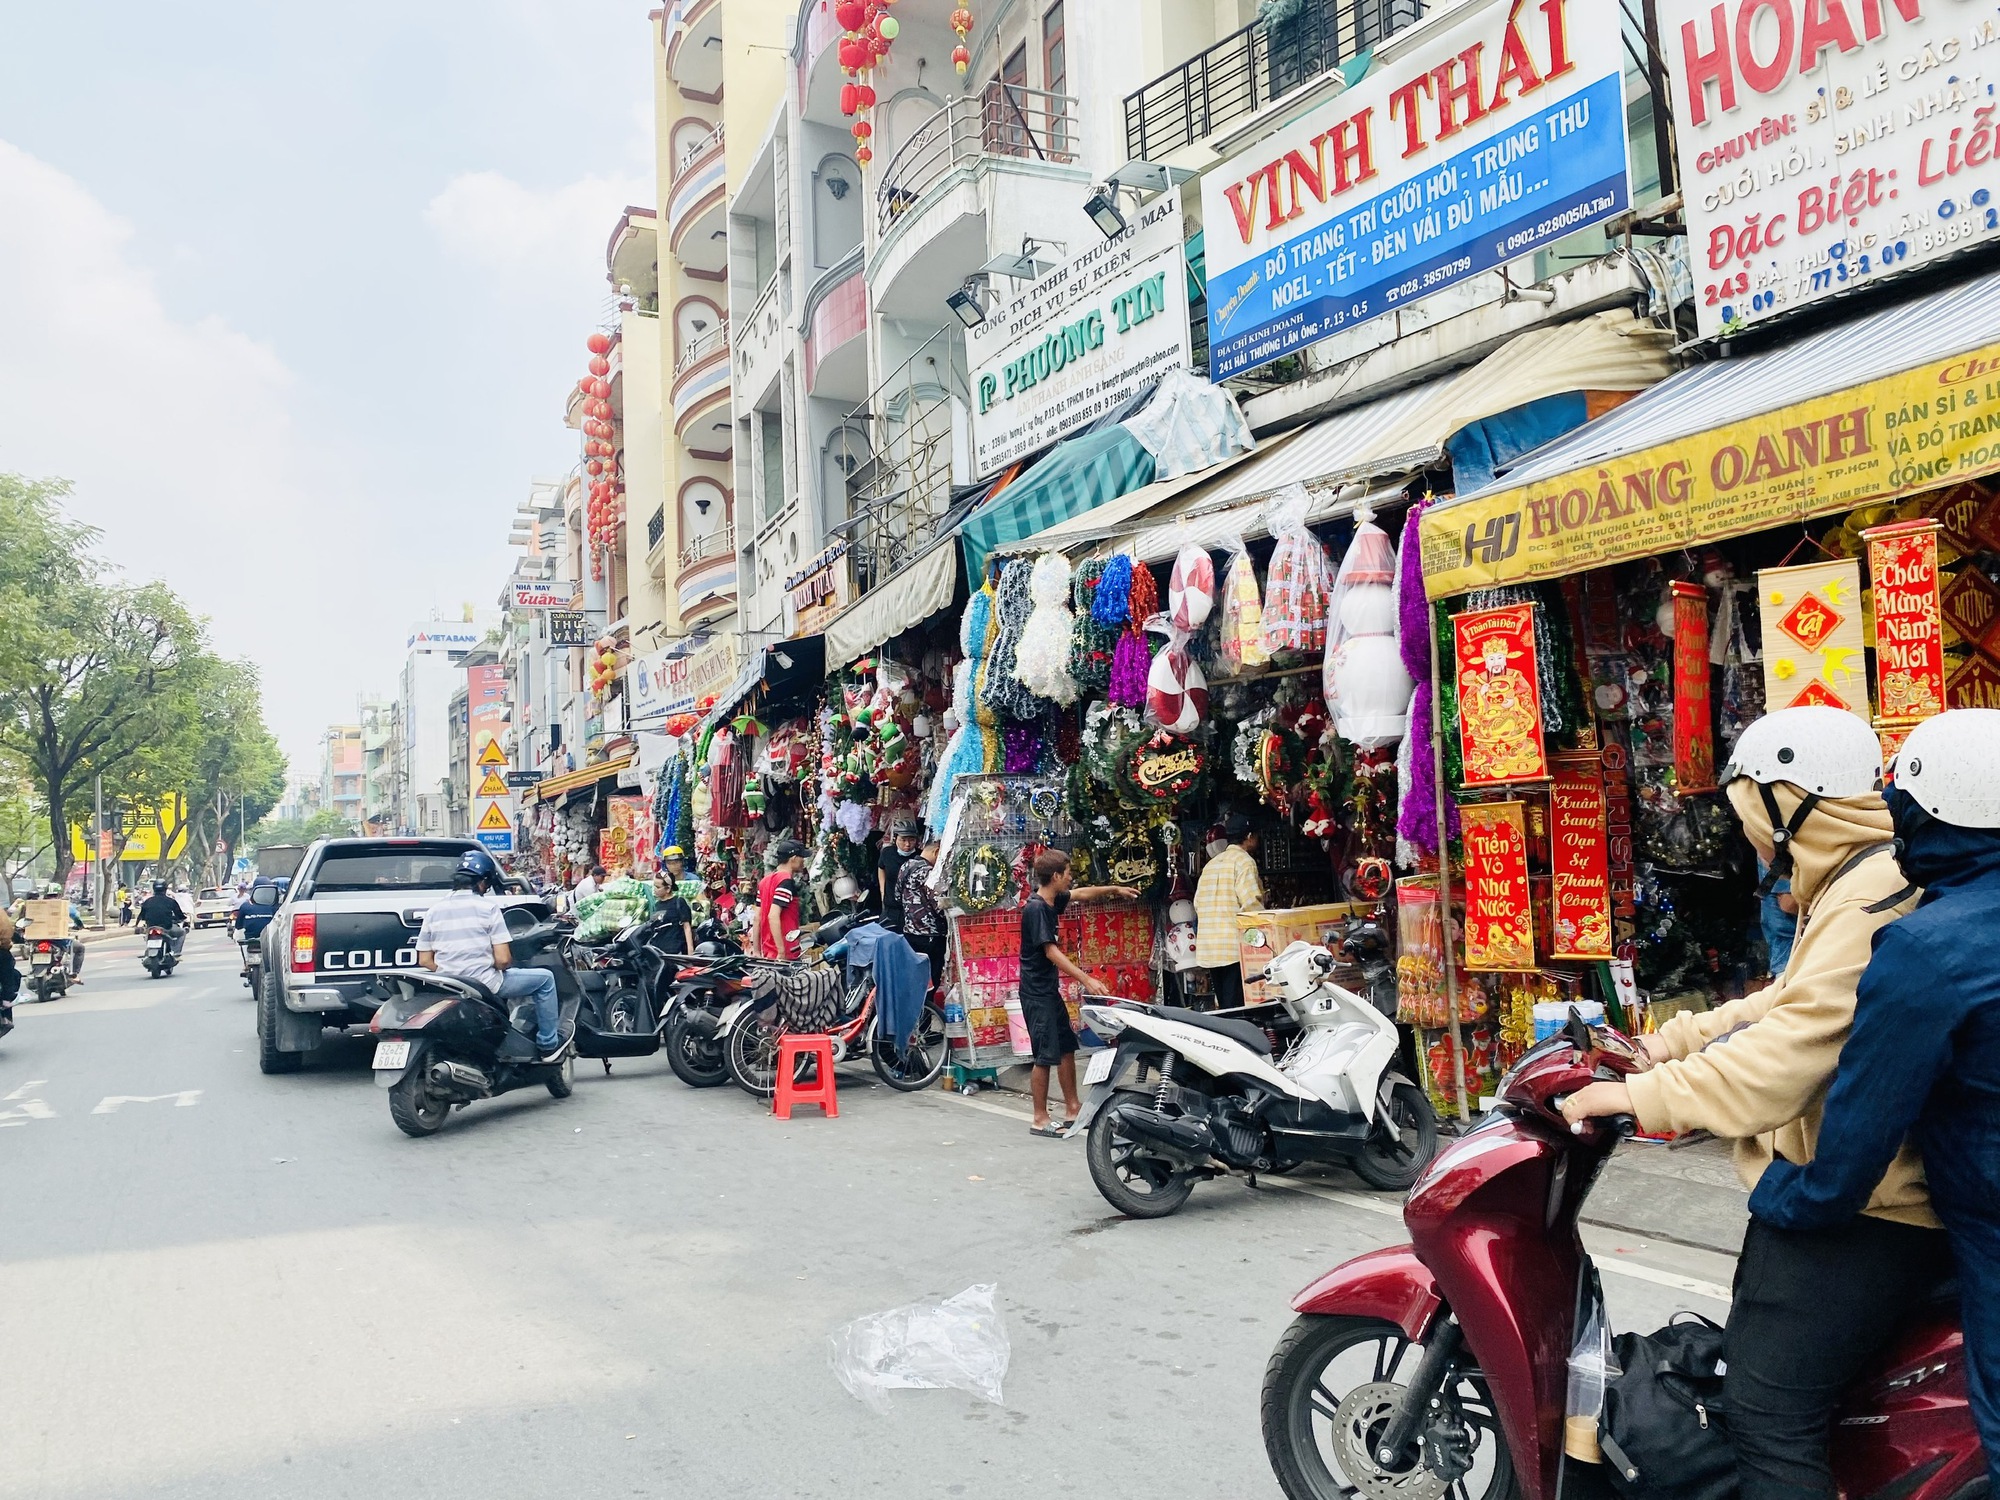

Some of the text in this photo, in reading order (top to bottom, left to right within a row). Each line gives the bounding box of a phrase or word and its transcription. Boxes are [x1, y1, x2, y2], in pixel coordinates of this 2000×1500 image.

[1223, 0, 1576, 244] VINH THÁI
[1696, 113, 1797, 174] CHUYÊN:
[1835, 86, 1854, 111] &
[1834, 109, 1896, 156] SINH
[1265, 97, 1590, 281] ĐỒ TRANG TRÍ CƯỚI HỎI TRUNG THU
[1707, 102, 2000, 271] Đặc Biệt: Liễ
[1010, 293, 1027, 315] TY
[1030, 270, 1069, 301] TNHH
[1141, 198, 1174, 231] MẠI
[1271, 275, 1312, 311] NOEL
[1326, 247, 1358, 285] TẾT
[1371, 229, 1406, 266] ĐÈN
[1412, 207, 1441, 245] VẢI
[1447, 190, 1474, 231] ĐỦ
[1836, 254, 1872, 283] 352
[1009, 307, 1043, 337] DỊCH
[1092, 248, 1132, 283] KIỆN
[1704, 271, 1750, 307] 243
[1002, 271, 1166, 401] PHƯƠNG TIN
[1248, 327, 1270, 344] KINH
[1272, 312, 1304, 334] DOANH
[1218, 358, 1233, 375] 241
[1885, 402, 1929, 430] BÁN
[1936, 389, 1956, 415] SỈ
[1964, 389, 1979, 407] &
[1887, 433, 1912, 458] VÀ
[1917, 420, 1944, 451] ĐỒ
[1528, 406, 1876, 539] HOÀNG OANH
[1743, 490, 1757, 500] 13
[1826, 458, 1880, 480] TP.HCM
[1889, 457, 1952, 488] CỔNG
[1636, 525, 1663, 537] 733
[1668, 517, 1694, 530] 515
[1707, 507, 1735, 521] 094
[1786, 487, 1816, 501] 352
[1881, 558, 1931, 588] Chúc
[1879, 590, 1934, 617] Mừng
[1885, 616, 1932, 642] Năm
[1891, 643, 1929, 670] Mới
[1557, 795, 1599, 809] Xuân
[1560, 812, 1597, 829] Sang
[1474, 831, 1510, 857] Tiền
[1562, 832, 1596, 850] Vạn
[1481, 856, 1504, 876] Vô
[1569, 852, 1590, 870] Sự
[1477, 877, 1512, 897] Như
[1556, 872, 1604, 888] Thành
[1476, 895, 1517, 918] Nước
[1562, 892, 1600, 910] Công
[1193, 1038, 1231, 1054] BLADE
